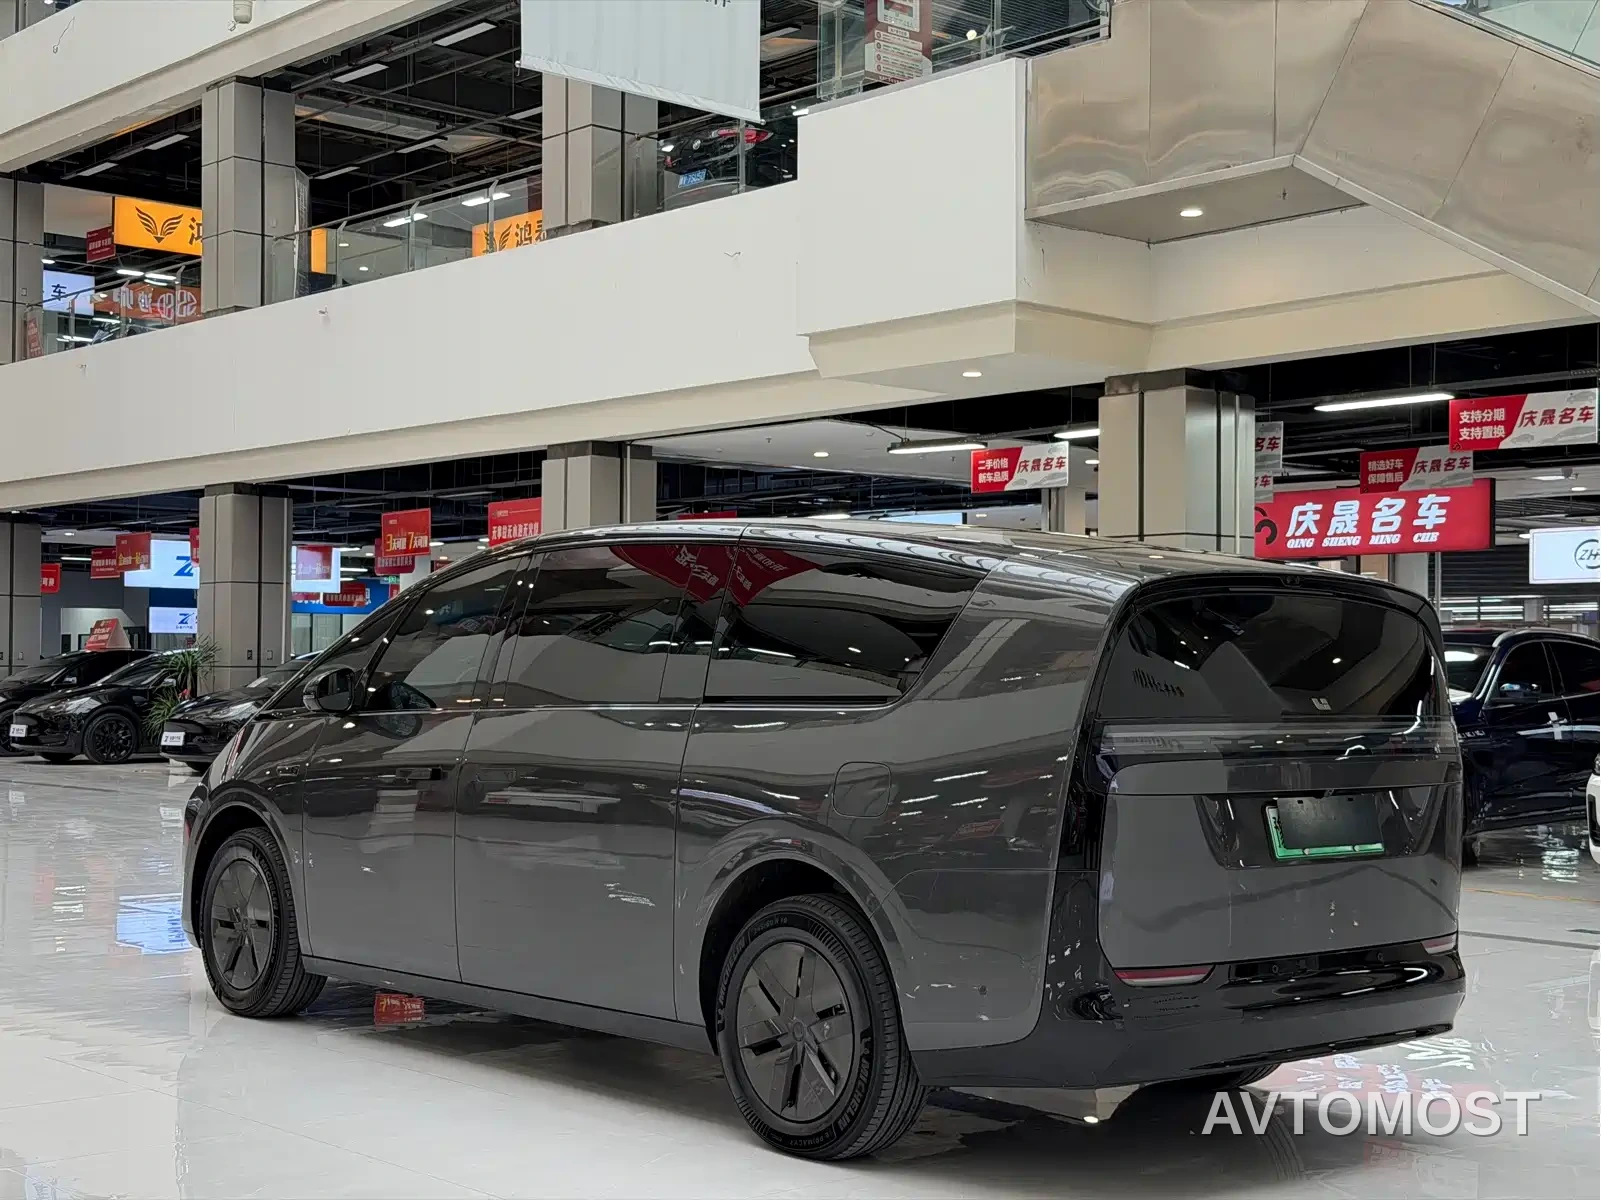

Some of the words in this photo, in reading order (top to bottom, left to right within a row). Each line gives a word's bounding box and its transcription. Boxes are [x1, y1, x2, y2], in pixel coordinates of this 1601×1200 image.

[1459, 407, 1506, 424] 支持分期
[1518, 405, 1595, 428] 庆晟名车
[1459, 425, 1506, 441] 支持置换
[977, 458, 1009, 471] 二手价格
[1017, 456, 1067, 474] 庆晟名车
[1367, 458, 1404, 471] 精选好车
[1412, 456, 1471, 475] 庆晟名车
[978, 471, 1009, 484] 新车品质
[1367, 471, 1404, 485] 保障售后
[1285, 493, 1452, 538] 庆晟名车
[1286, 537, 1315, 549] QING
[1322, 535, 1362, 547] SHENG
[1369, 533, 1401, 545] MING
[1412, 532, 1440, 543] CHE
[837, 1057, 870, 1132] MICHELIN
